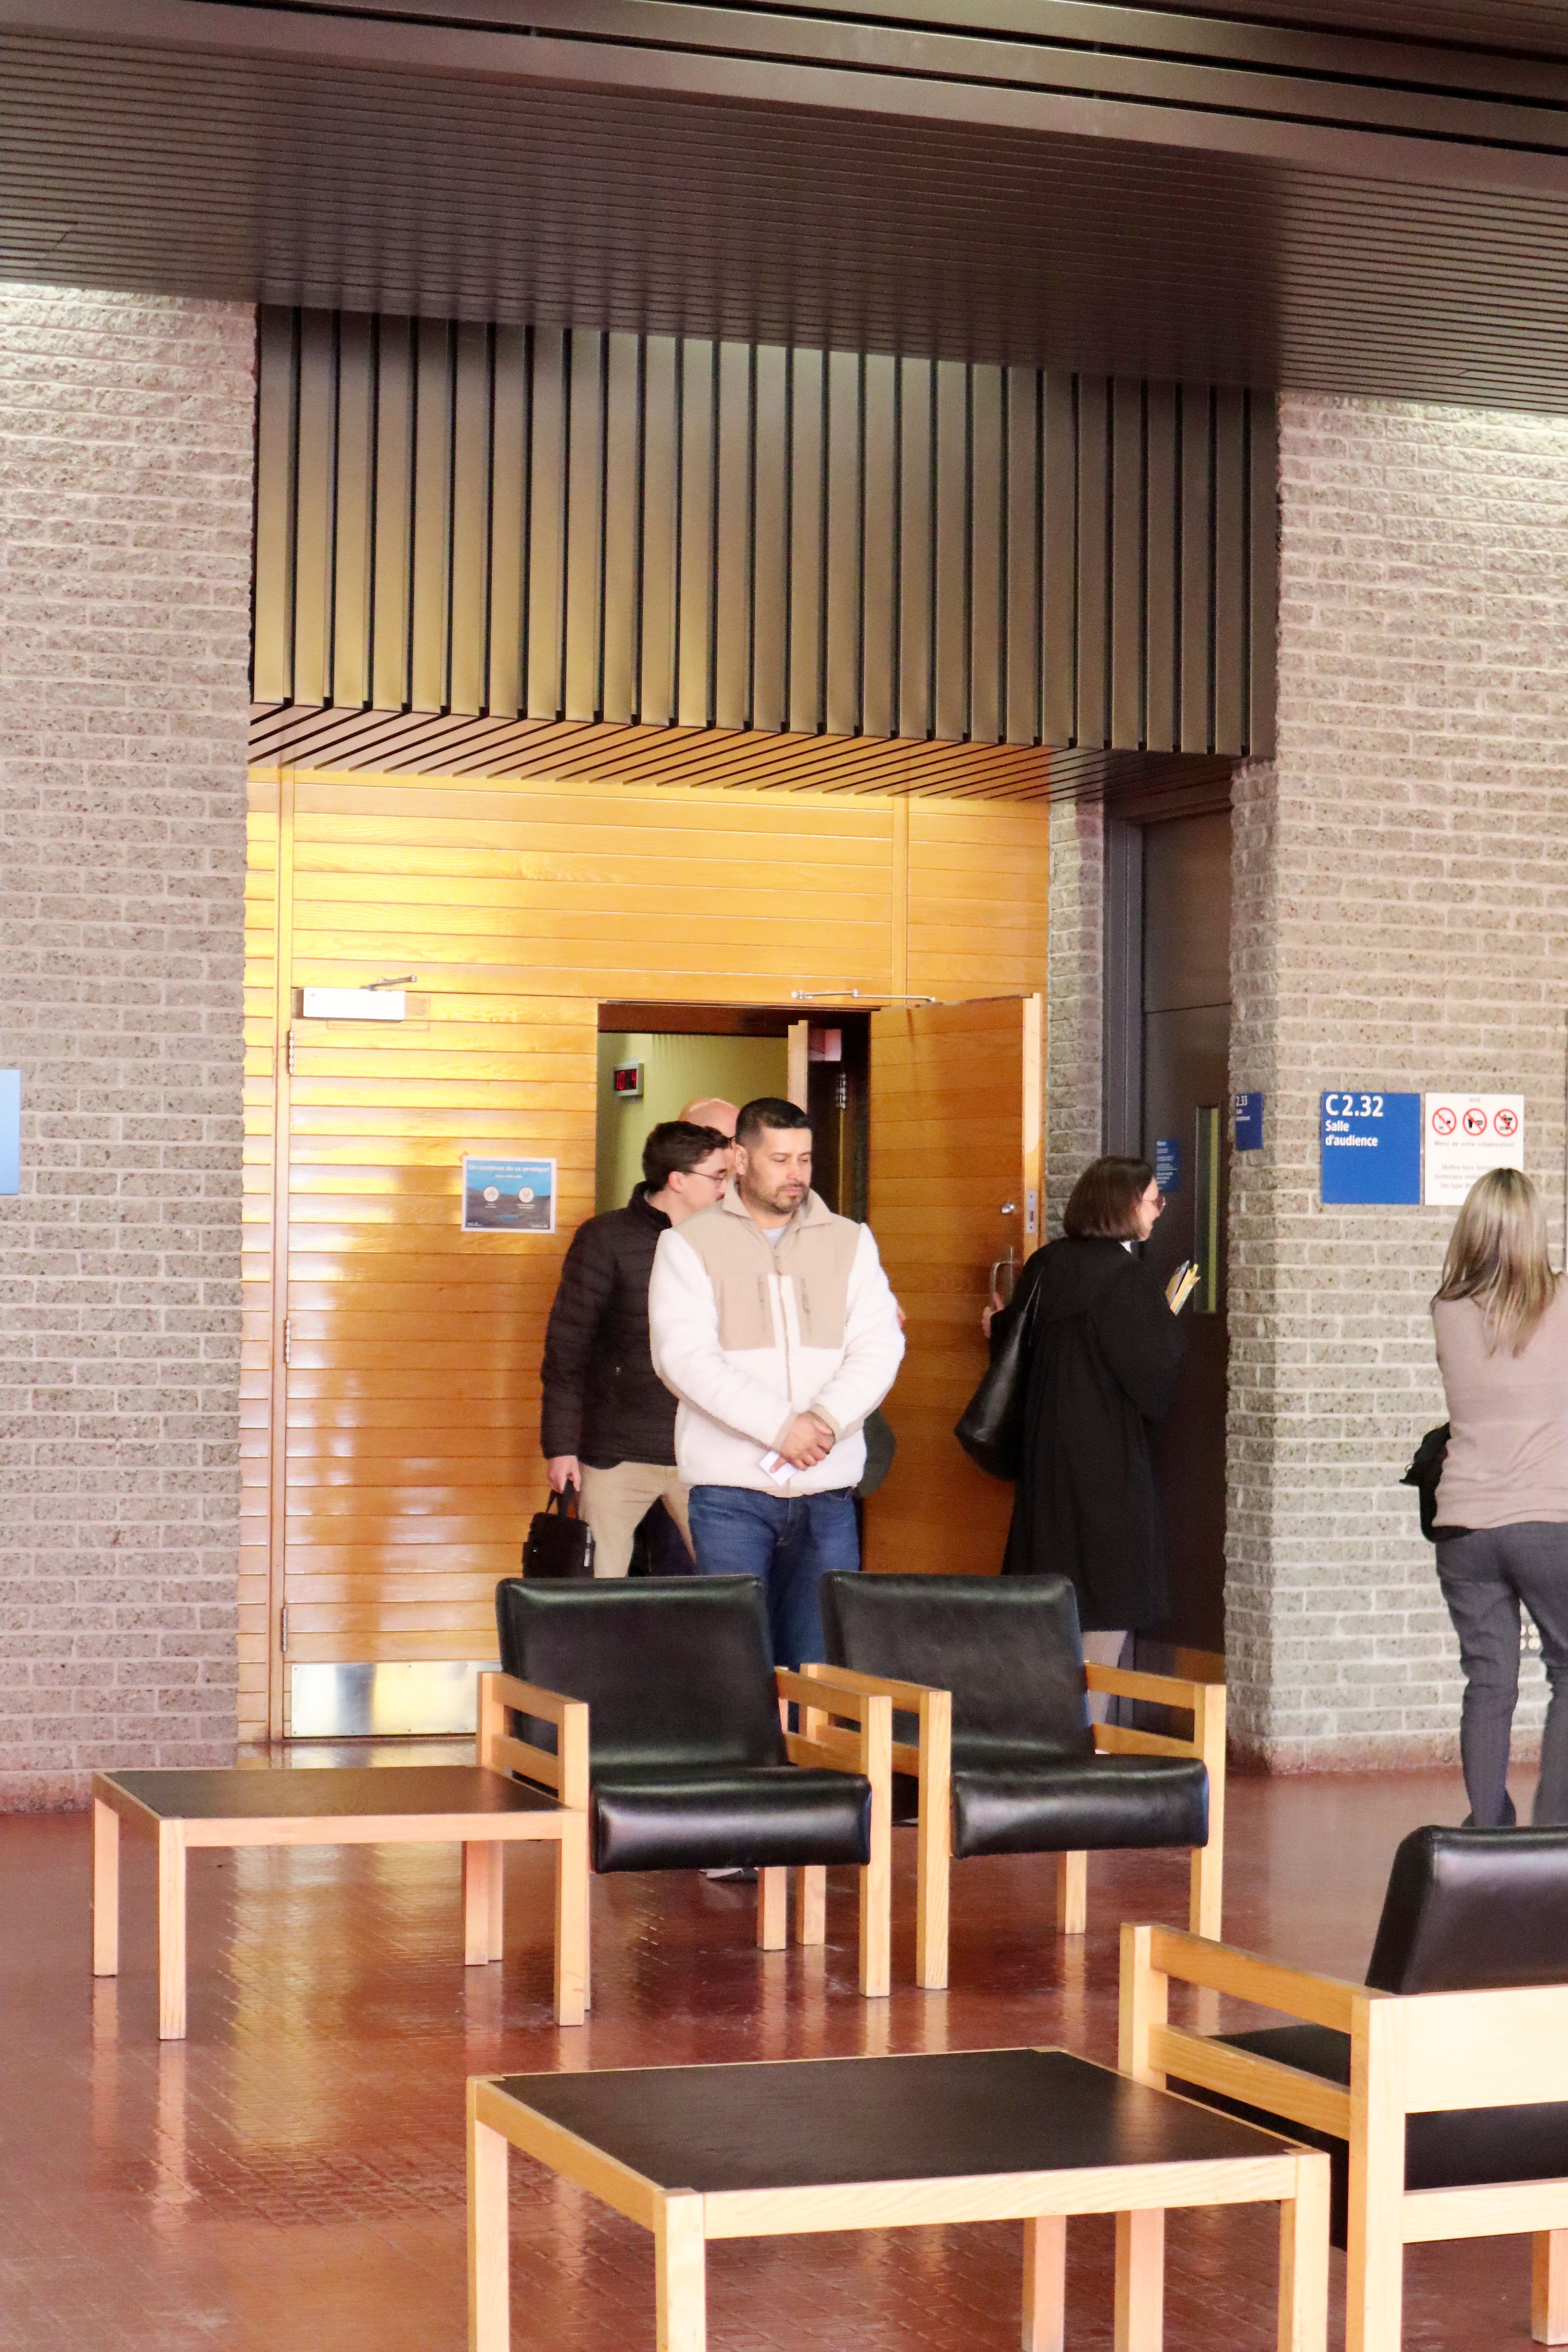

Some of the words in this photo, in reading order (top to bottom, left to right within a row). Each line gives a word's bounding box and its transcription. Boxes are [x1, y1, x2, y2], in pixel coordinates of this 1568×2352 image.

[1326, 1094, 1339, 1116] C
[1342, 1095, 1383, 1117] 2.32
[1325, 1120, 1349, 1132] Salle
[1325, 1134, 1378, 1147] d'audience
